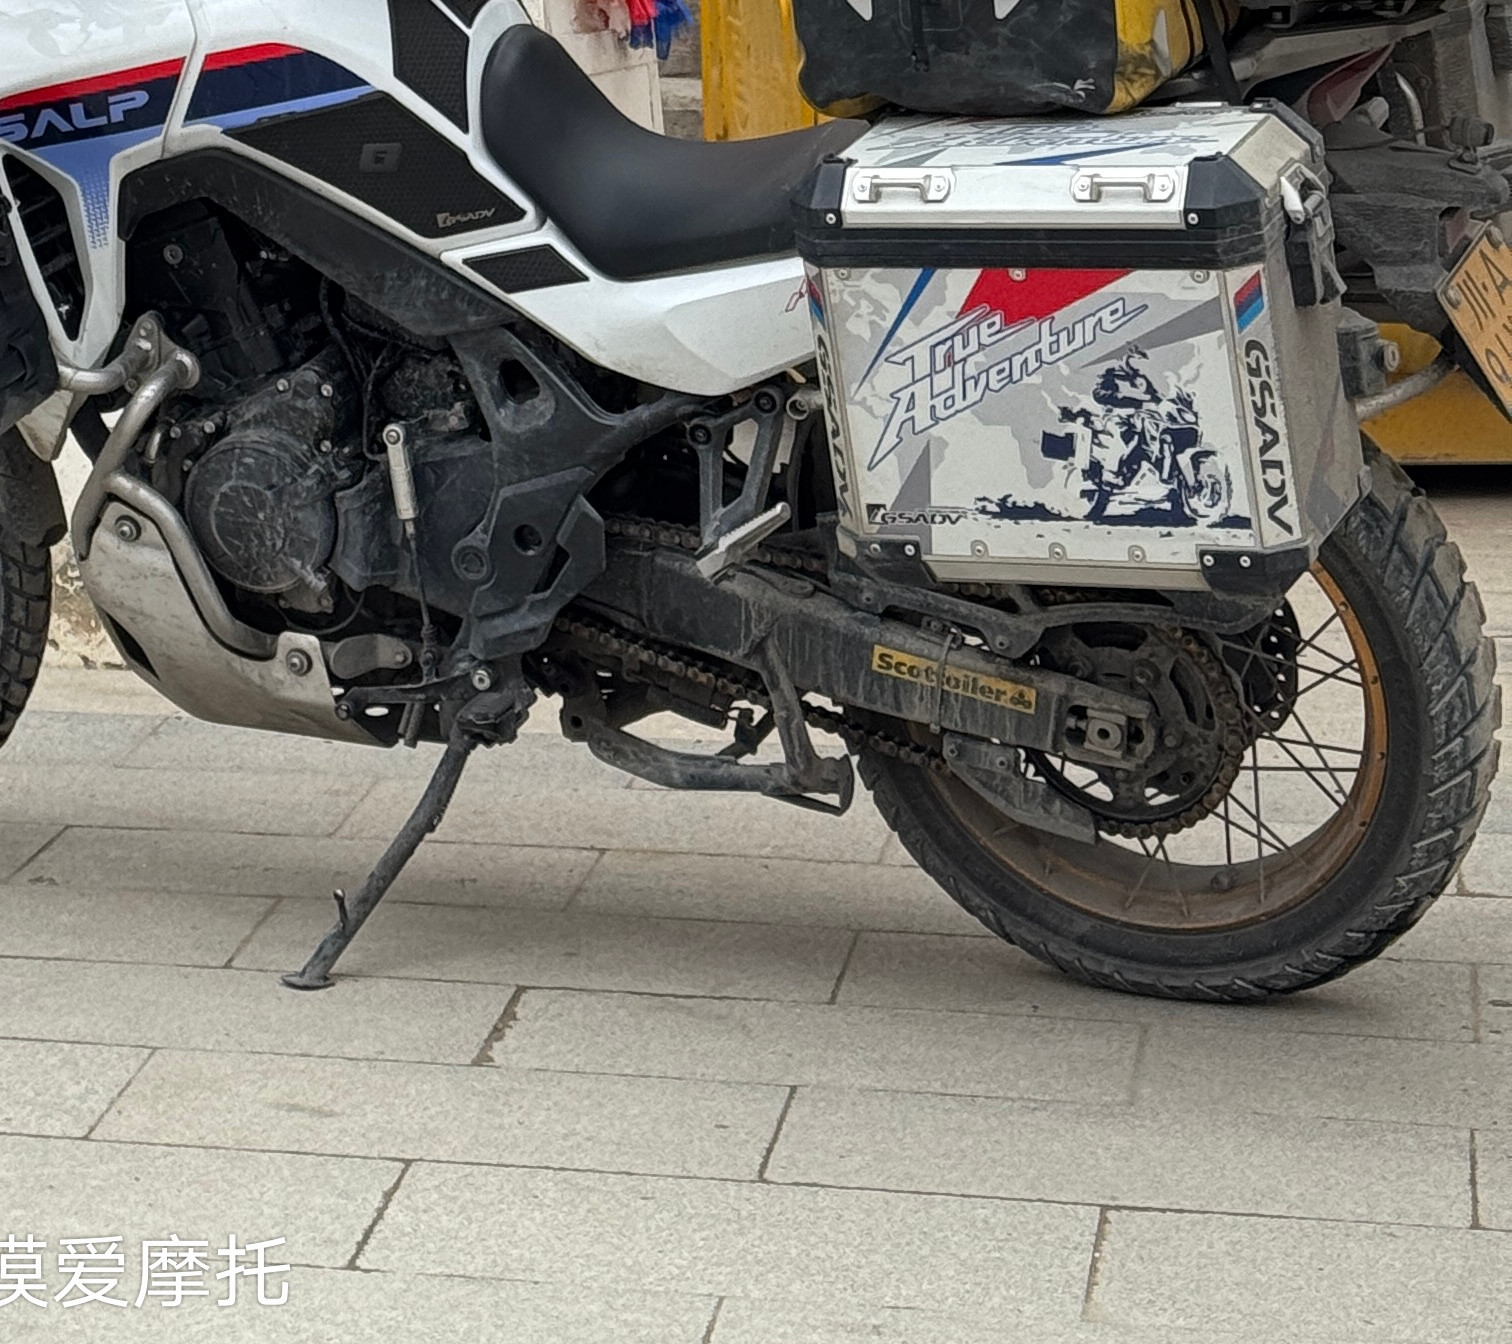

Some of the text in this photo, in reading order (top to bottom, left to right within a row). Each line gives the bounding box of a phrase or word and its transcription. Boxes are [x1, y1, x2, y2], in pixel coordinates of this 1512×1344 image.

[866, 296, 1149, 472] Adventure
[884, 303, 1037, 383] True
[1243, 339, 1294, 538] GSADV
